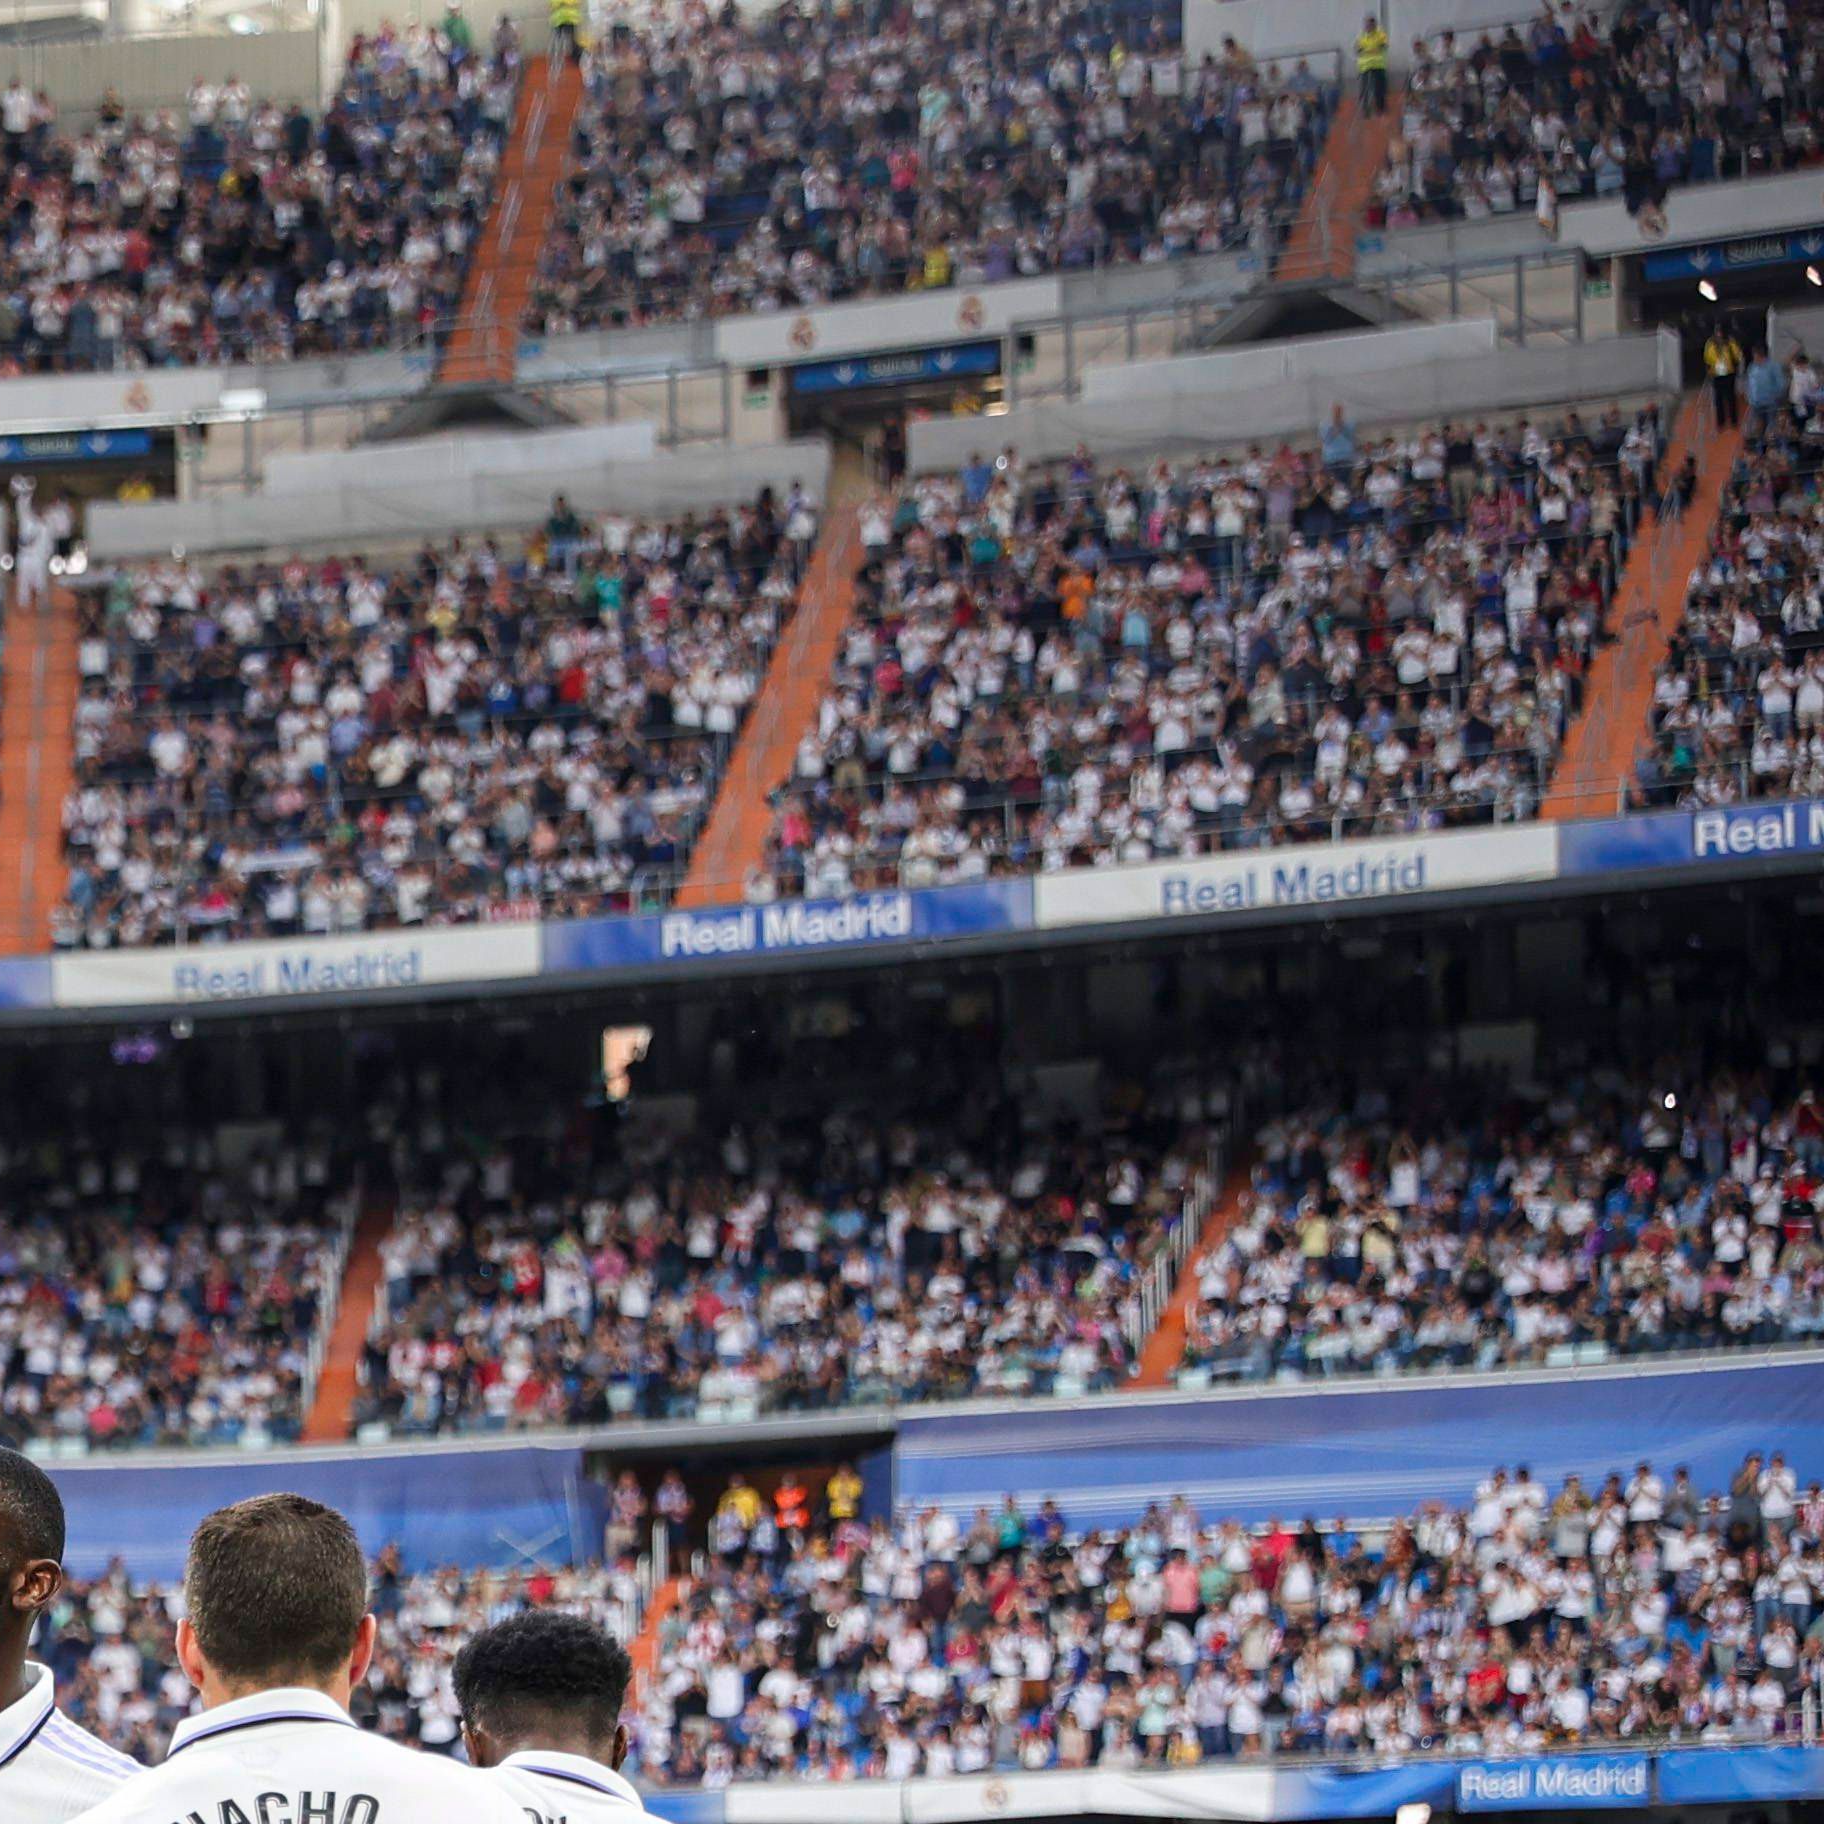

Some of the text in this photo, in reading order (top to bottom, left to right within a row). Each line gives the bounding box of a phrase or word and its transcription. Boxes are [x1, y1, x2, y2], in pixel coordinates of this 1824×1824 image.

[1694, 805, 1796, 857] Real
[1161, 852, 1427, 914] Real Madrid
[661, 892, 911, 958] Real Madrid
[174, 948, 421, 996] Real Madrid
[1461, 1760, 1647, 1800] Real Madrid
